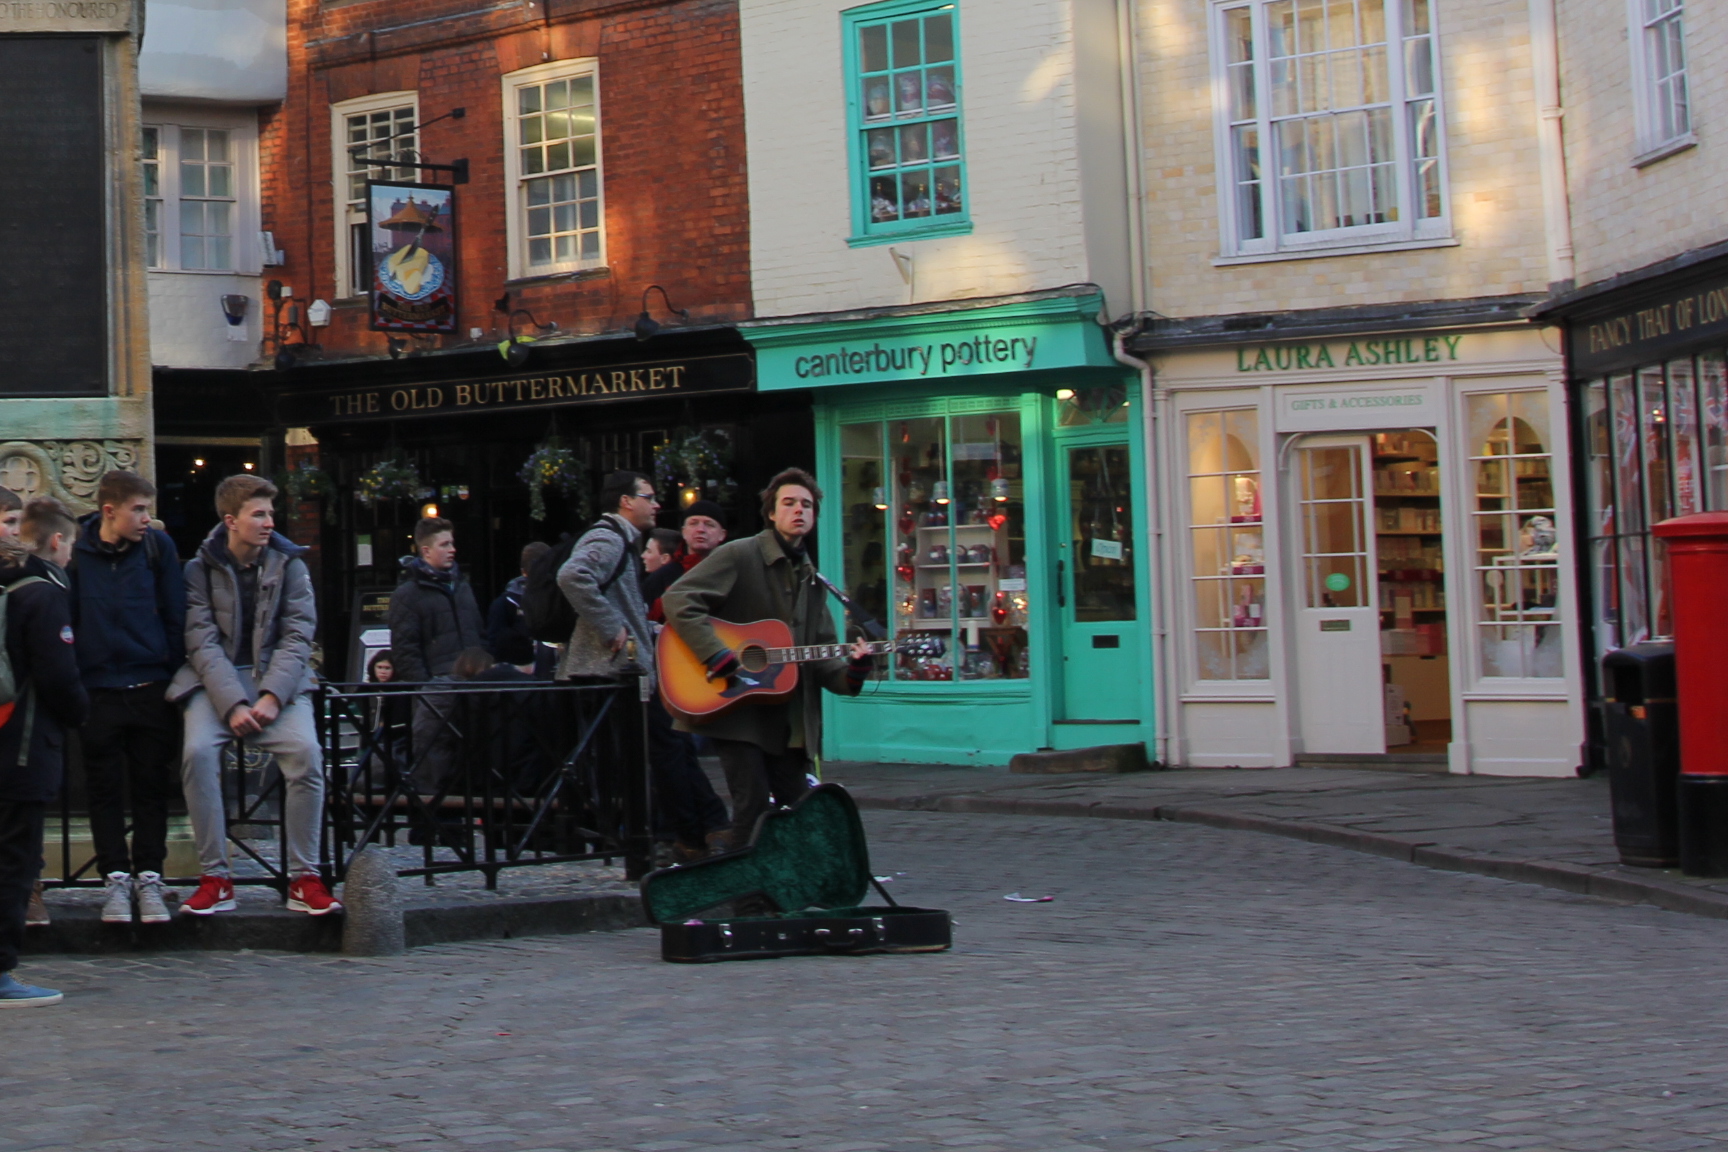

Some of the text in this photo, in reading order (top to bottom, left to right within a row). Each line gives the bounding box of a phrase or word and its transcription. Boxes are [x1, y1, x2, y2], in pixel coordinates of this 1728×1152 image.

[1589, 315, 1632, 354] FANCY
[1636, 304, 1671, 340] THAT
[1675, 298, 1694, 330] OF
[795, 334, 1037, 379] canterbury pottery
[1236, 335, 1463, 373] LAURA ASHLEY
[329, 365, 686, 417] THE OLD BUTTERMARKET
[1291, 394, 1423, 412] GIFTS & ACCESSORIES
